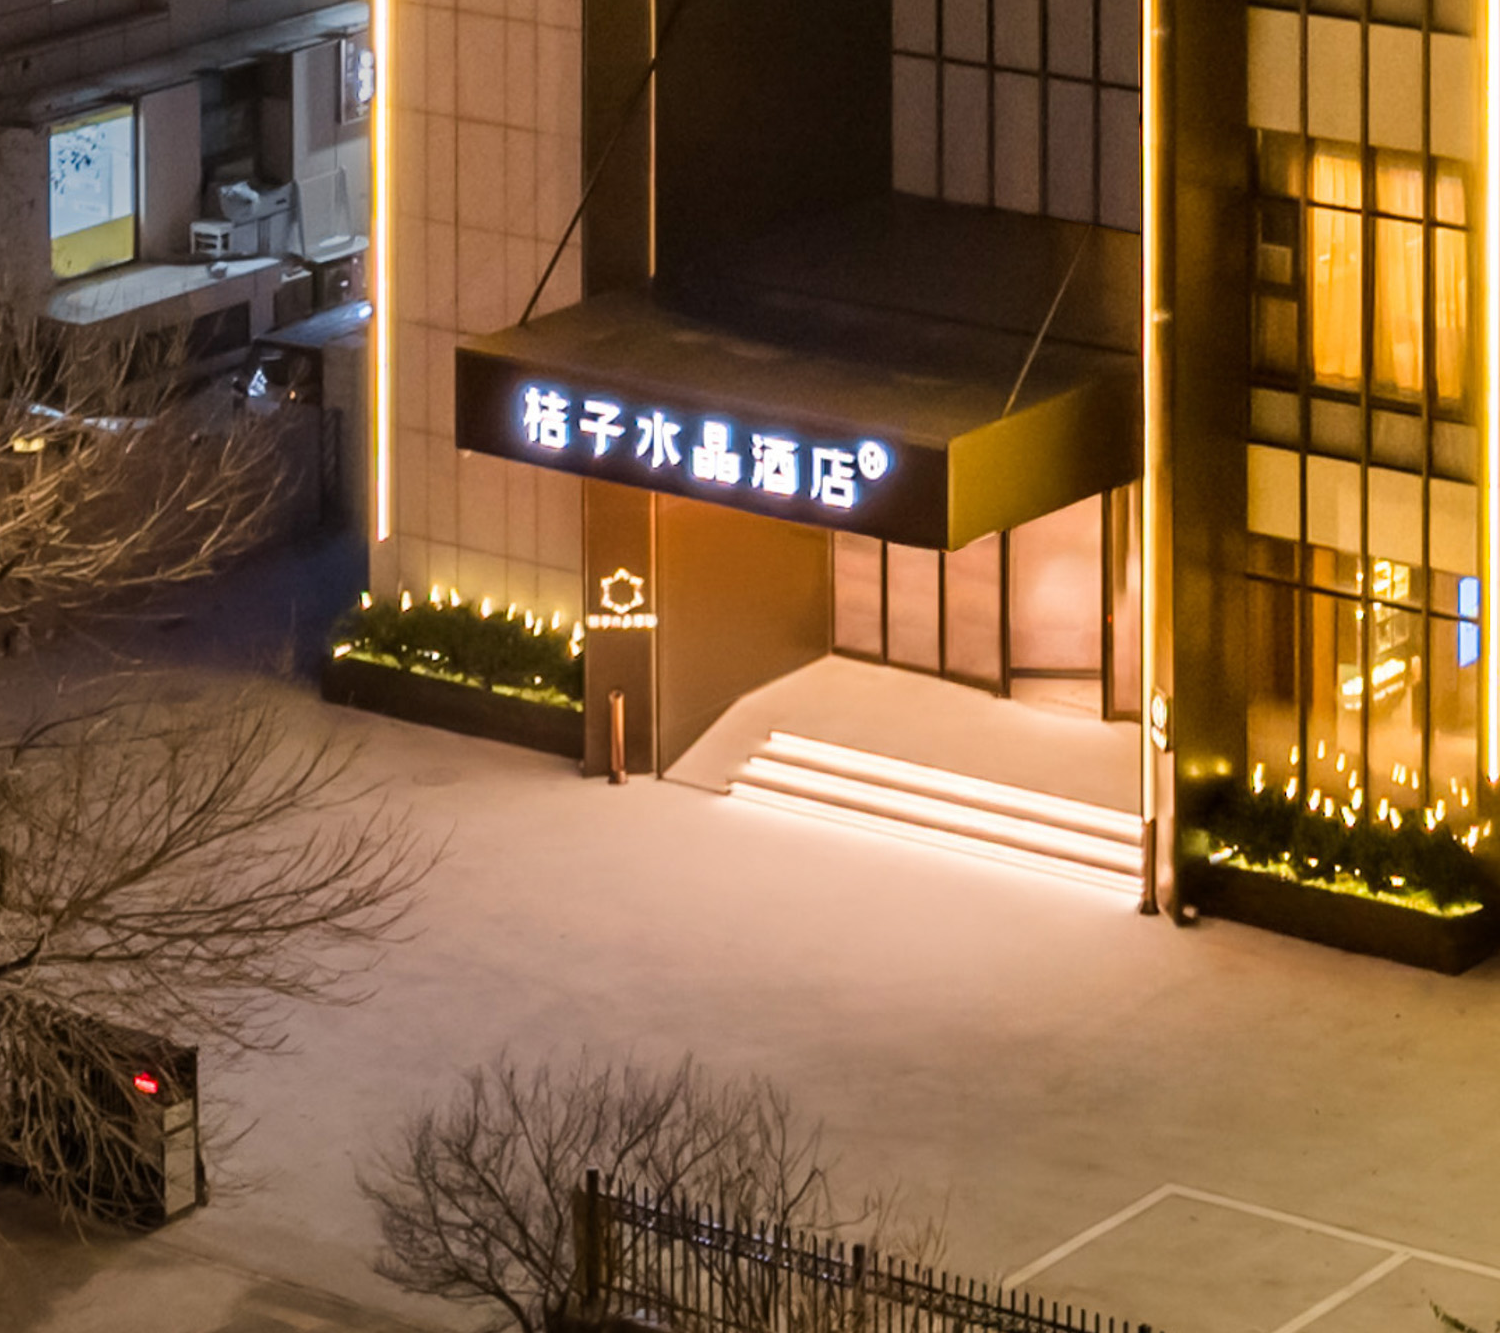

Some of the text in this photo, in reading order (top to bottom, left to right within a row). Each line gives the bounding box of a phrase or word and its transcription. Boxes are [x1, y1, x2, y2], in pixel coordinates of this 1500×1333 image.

[522, 386, 856, 509] 桔子水晶酒店
